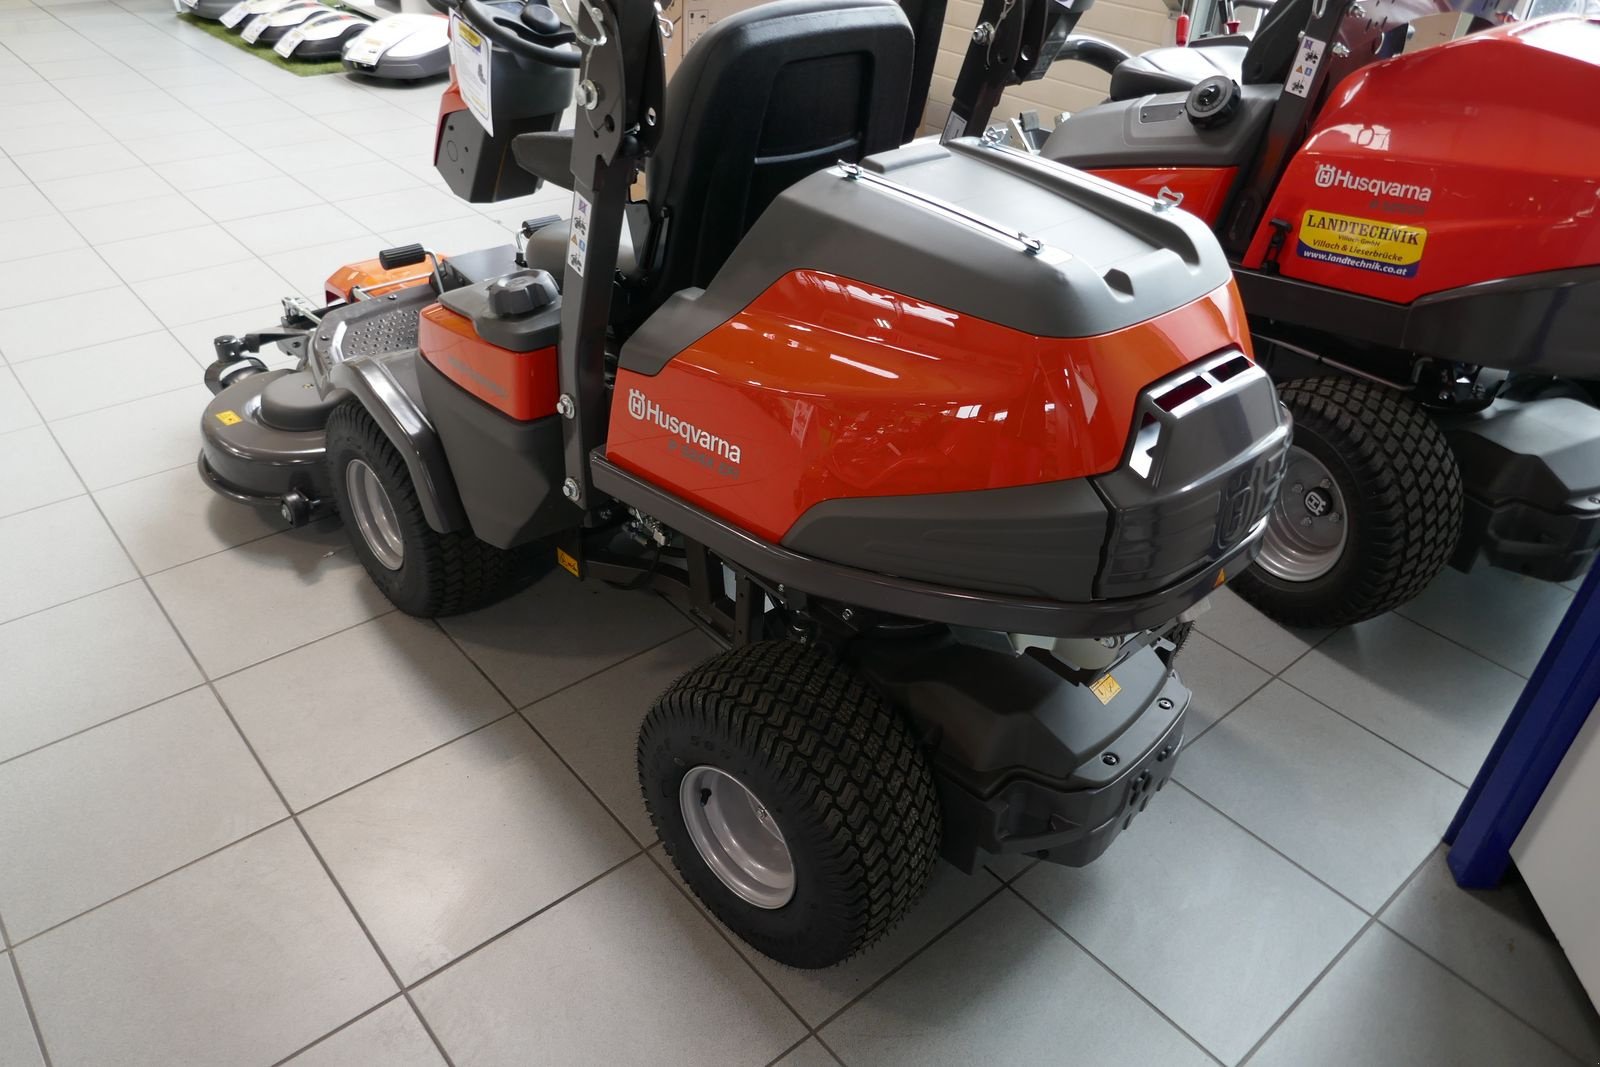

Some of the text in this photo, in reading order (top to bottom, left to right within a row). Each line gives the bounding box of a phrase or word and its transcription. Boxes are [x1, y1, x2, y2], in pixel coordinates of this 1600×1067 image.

[1334, 170, 1432, 202] Husqvarna
[1307, 214, 1420, 246] LANDTECHNIK
[1303, 250, 1408, 276] www.landtechnik.co.at
[1312, 239, 1403, 262] Villach & Lieserbrücke
[646, 400, 741, 464] Husqvarna
